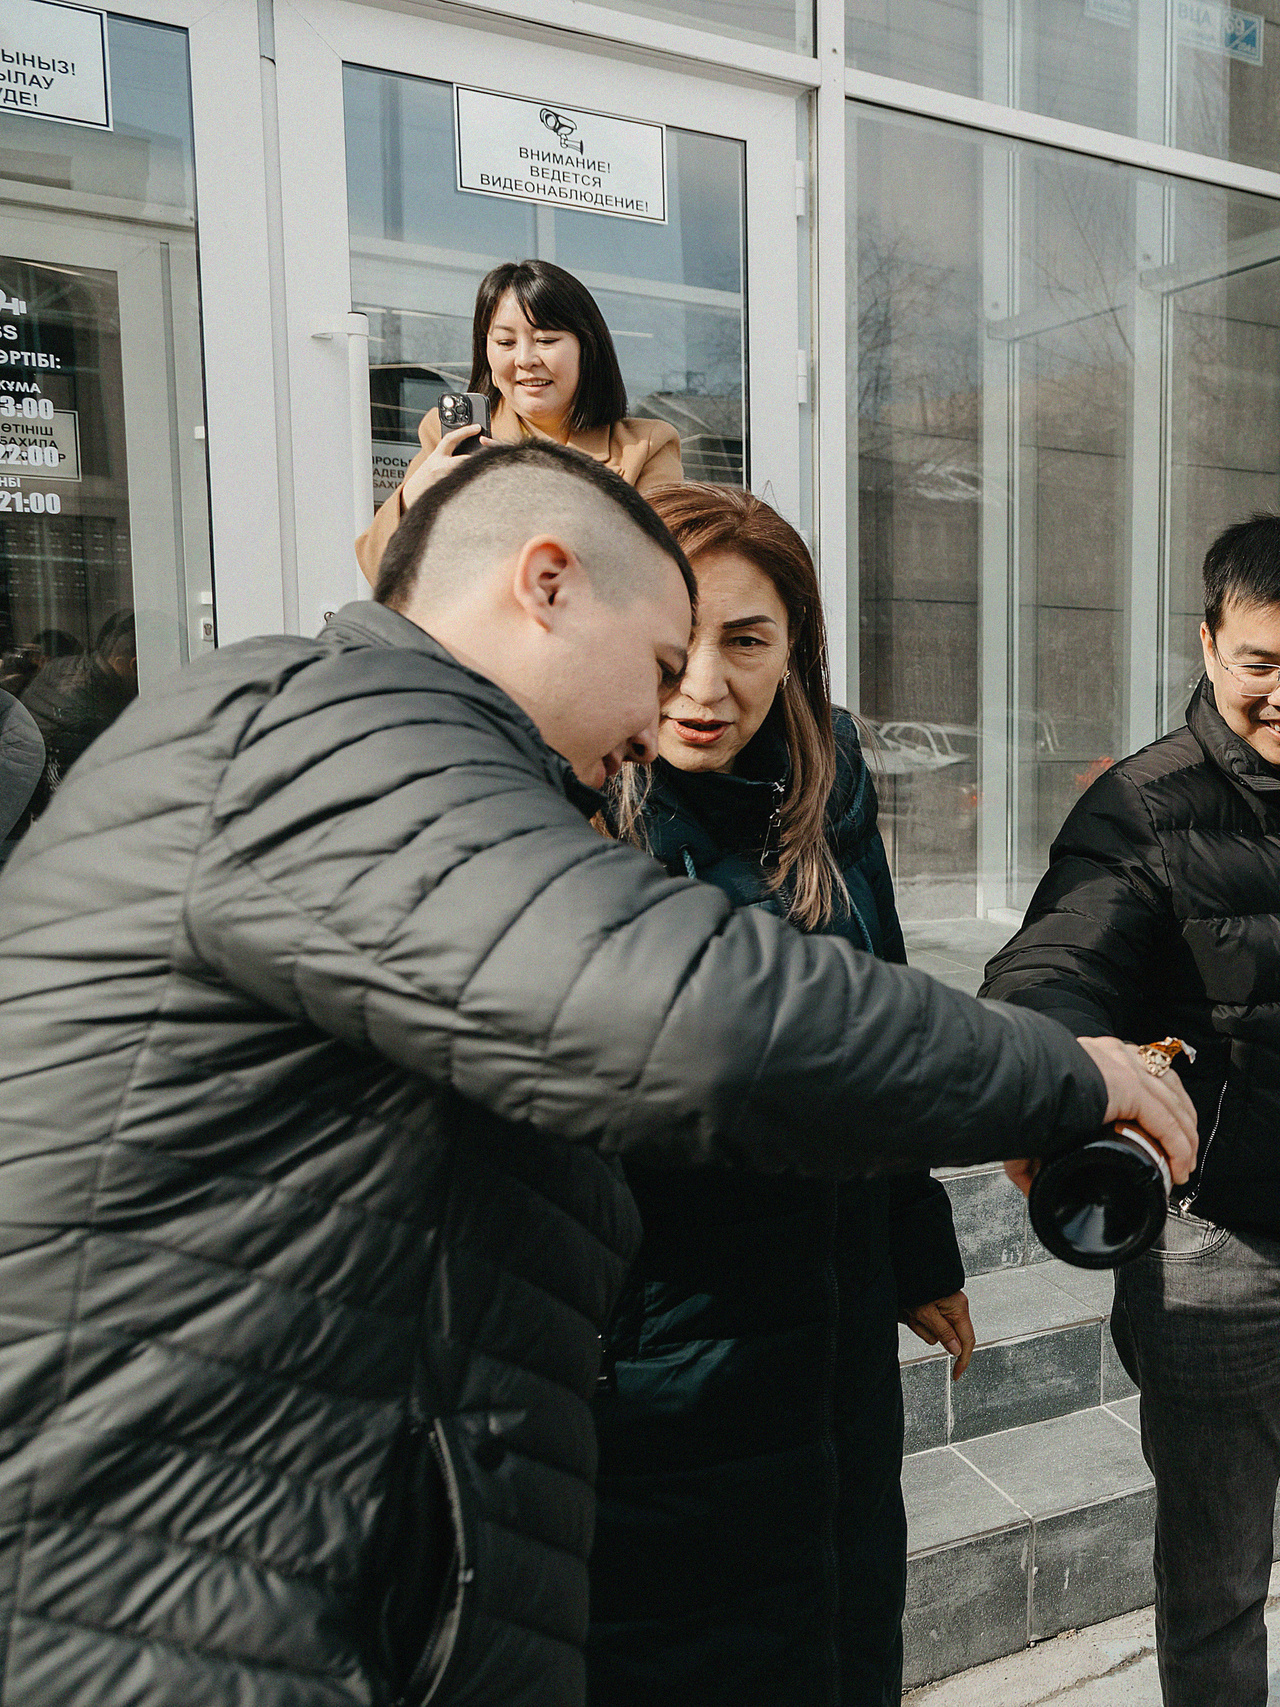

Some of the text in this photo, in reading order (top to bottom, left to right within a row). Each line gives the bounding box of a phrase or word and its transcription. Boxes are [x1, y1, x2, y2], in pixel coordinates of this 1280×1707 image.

[1, 49, 76, 76] ЫНЫЗ!
[0, 88, 38, 107] ДЕ!
[519, 147, 611, 173] ВНИМАНИЕ!
[530, 165, 602, 188] ВЕДЕТСЯ
[480, 174, 649, 212] ВИДЕОНАБЛЮДЕНИЕ!
[1, 423, 53, 436] ӨТІНІШ
[372, 456, 412, 467] РОСЬ
